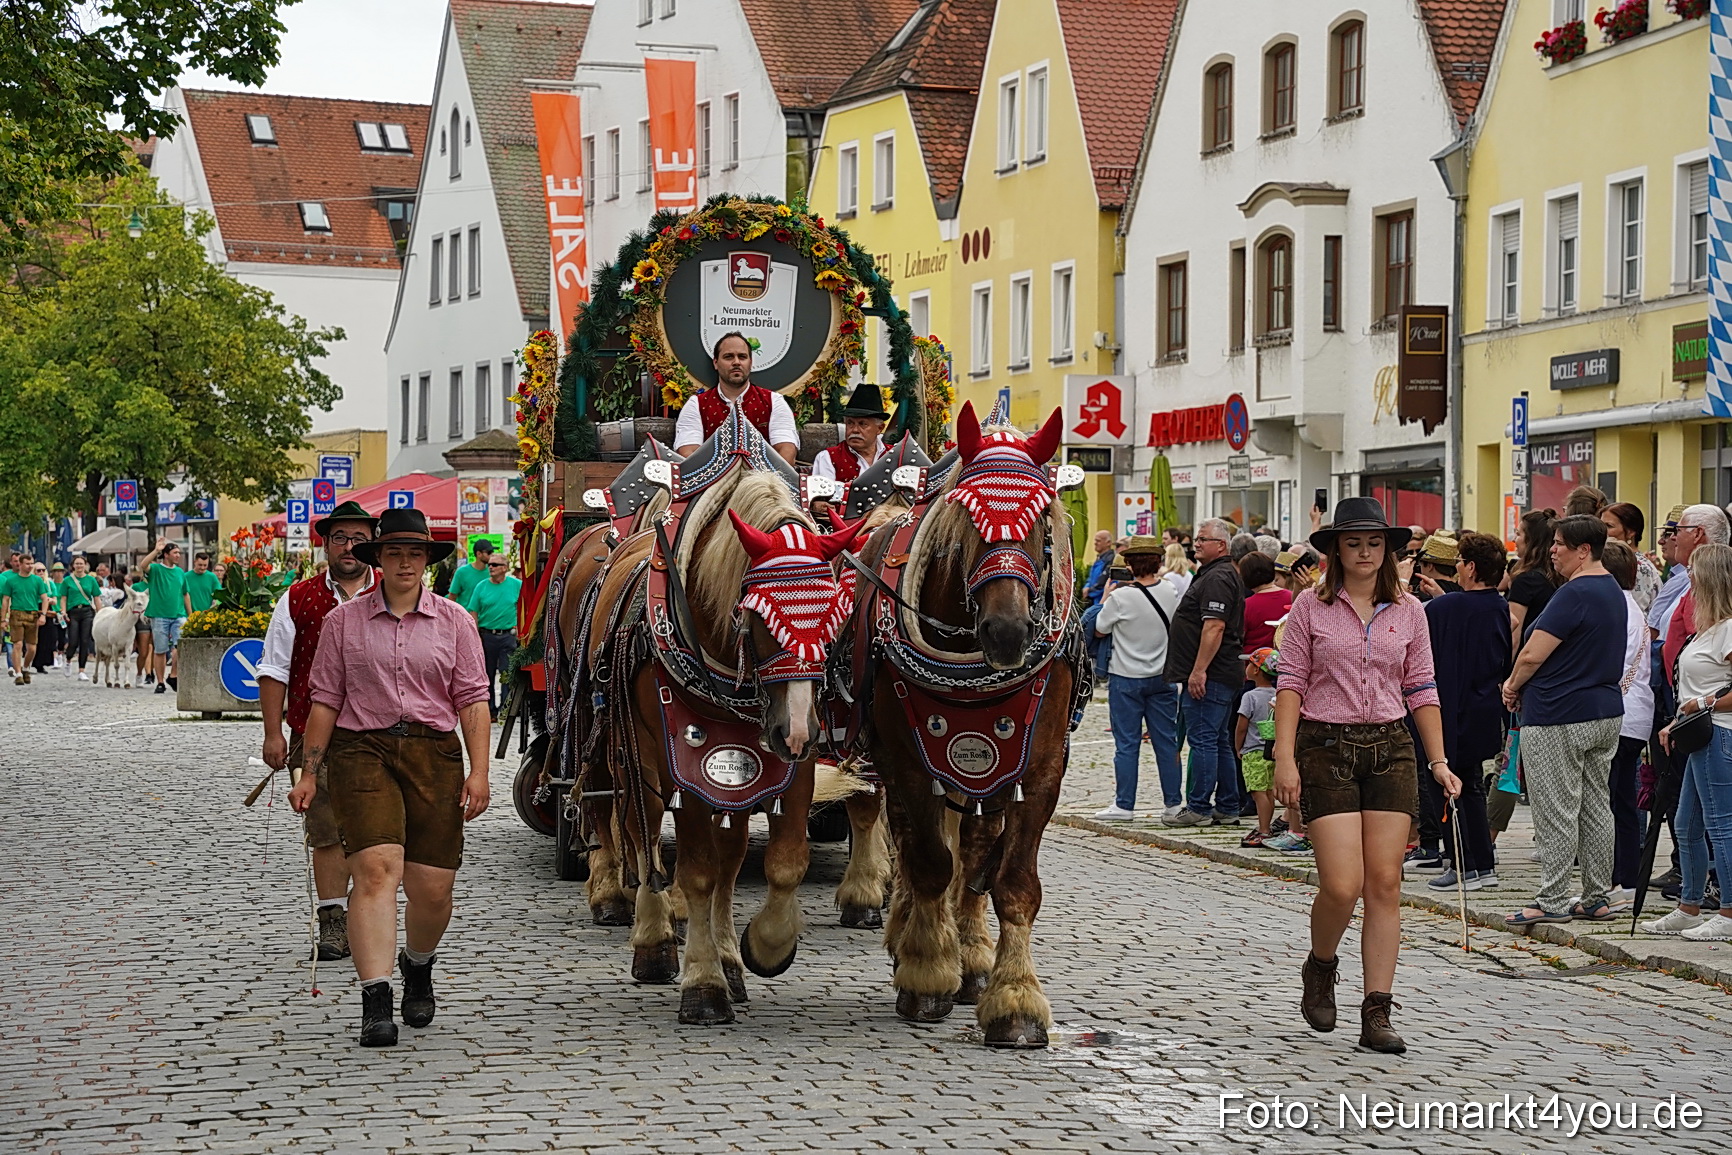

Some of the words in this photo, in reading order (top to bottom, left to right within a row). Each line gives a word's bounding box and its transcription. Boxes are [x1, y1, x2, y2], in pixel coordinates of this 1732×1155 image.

[904, 246, 948, 279] Lehmeier
[739, 289, 757, 297] 1628
[722, 306, 772, 316] Neumarkter
[713, 314, 781, 329] Lammsbräu
[1551, 361, 1578, 381] WOLLE
[1584, 357, 1607, 377] MEHR
[1514, 403, 1523, 440] P
[1530, 444, 1560, 465] WOLLE
[1568, 441, 1593, 462] MEHR
[118, 501, 136, 510] TAXI
[291, 501, 305, 521] P
[314, 502, 335, 512] TAXI
[953, 751, 969, 759] Zum
[708, 762, 727, 770] Zum
